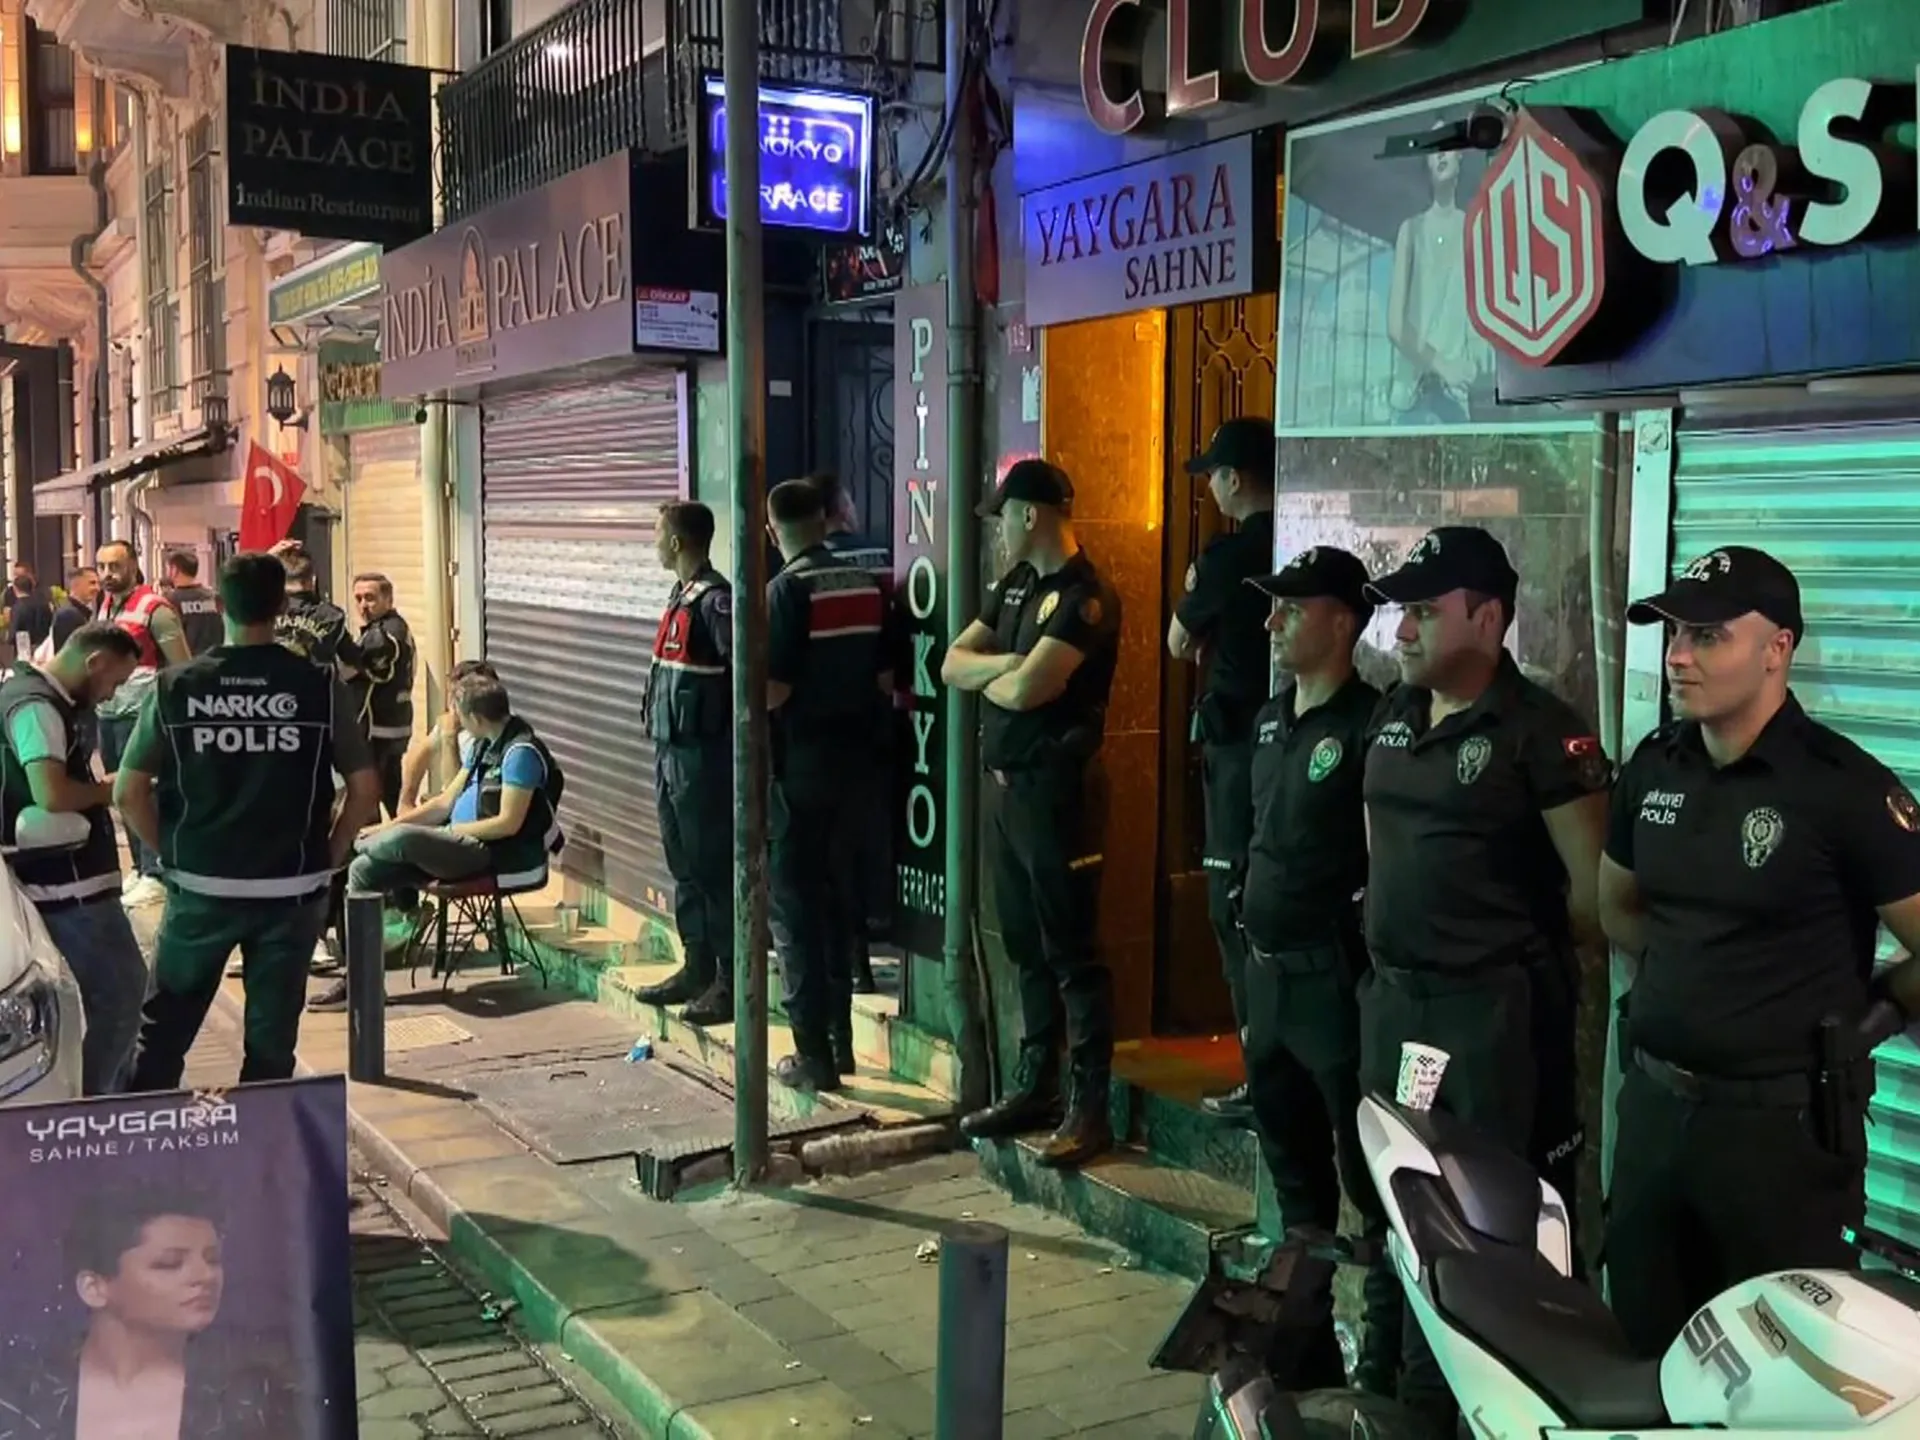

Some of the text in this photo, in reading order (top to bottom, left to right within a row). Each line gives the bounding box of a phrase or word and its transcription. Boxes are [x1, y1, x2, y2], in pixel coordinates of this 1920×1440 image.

[243, 121, 416, 174] PALACE
[759, 135, 843, 164] NOKYO
[1036, 163, 1236, 267] YAYGARA
[492, 211, 628, 332] PALACE
[1125, 238, 1237, 300] SAHNE
[26, 1103, 238, 1142] YAYGARA
[29, 1140, 119, 1164] SAHNE
